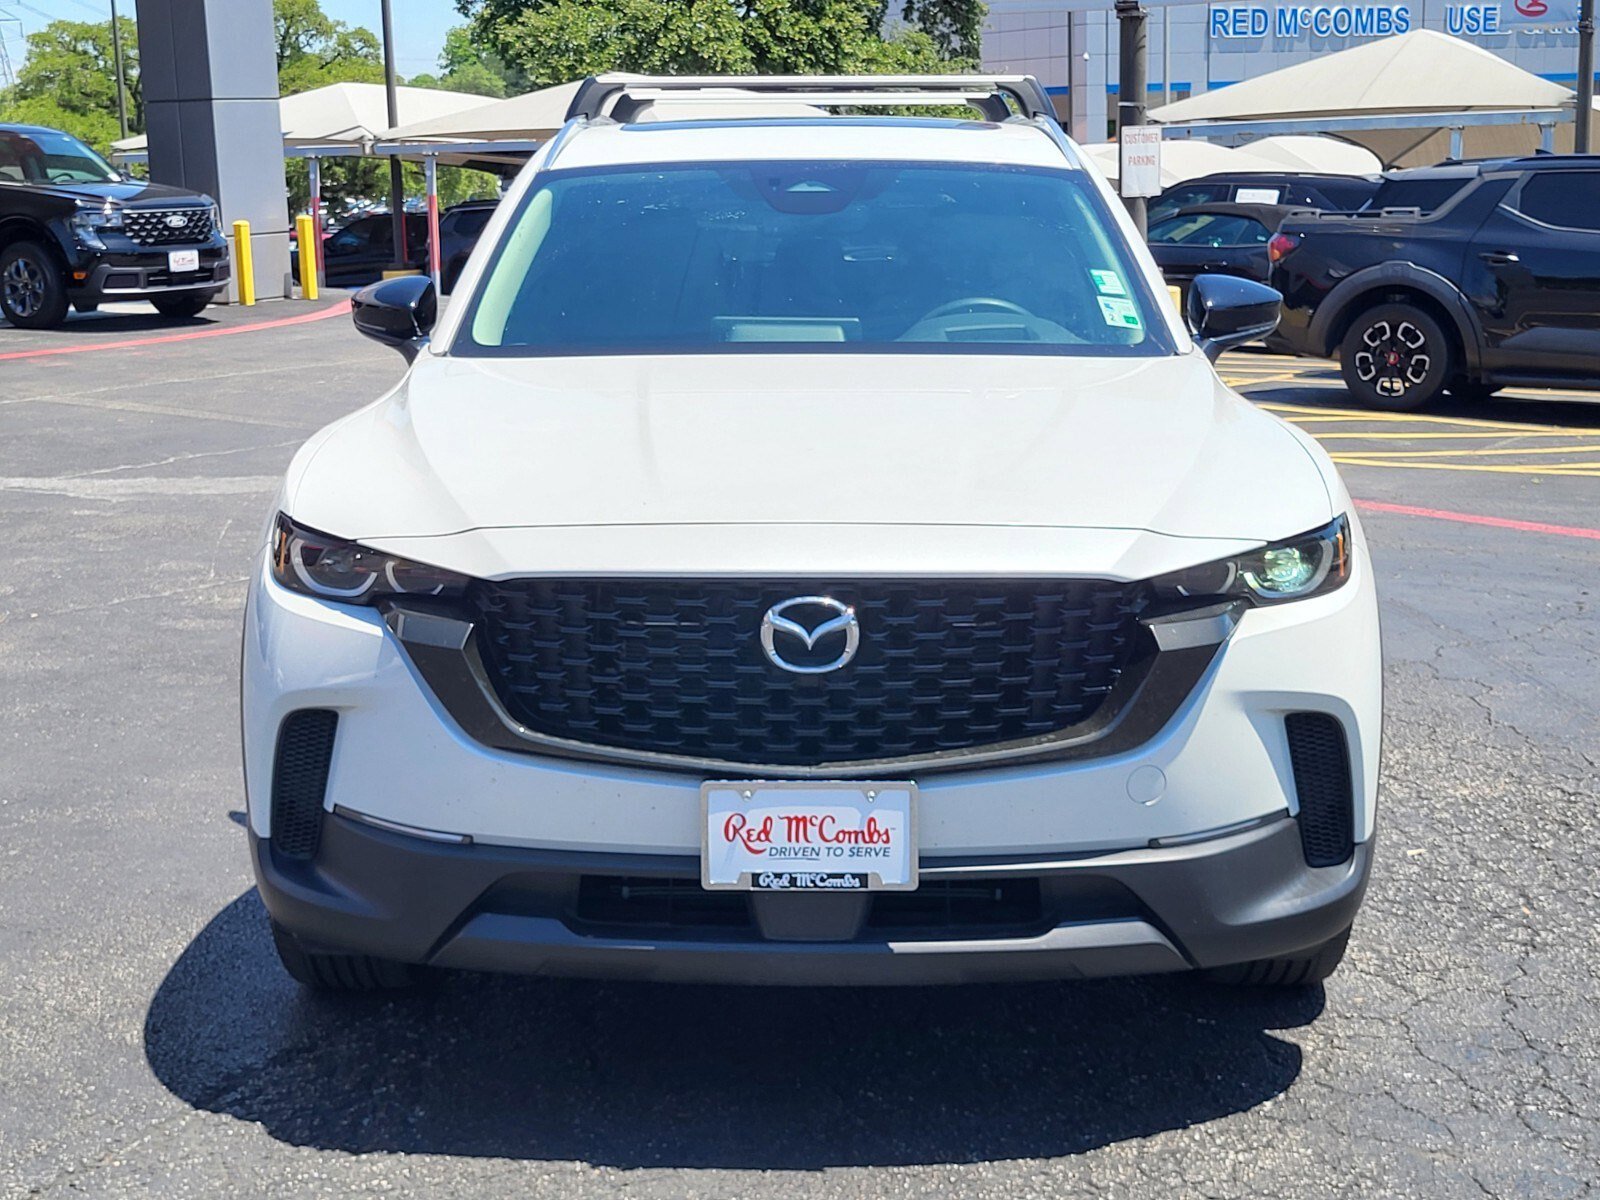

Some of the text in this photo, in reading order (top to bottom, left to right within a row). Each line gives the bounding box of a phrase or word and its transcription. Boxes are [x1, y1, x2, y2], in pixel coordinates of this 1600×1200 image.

[1211, 6, 1512, 37] RED McCOMBS USE
[1125, 133, 1158, 144] CUSTOMER
[724, 812, 890, 855] Red McCombs
[768, 846, 891, 857] DRIVEN TO SERVE
[758, 872, 790, 889] Red
